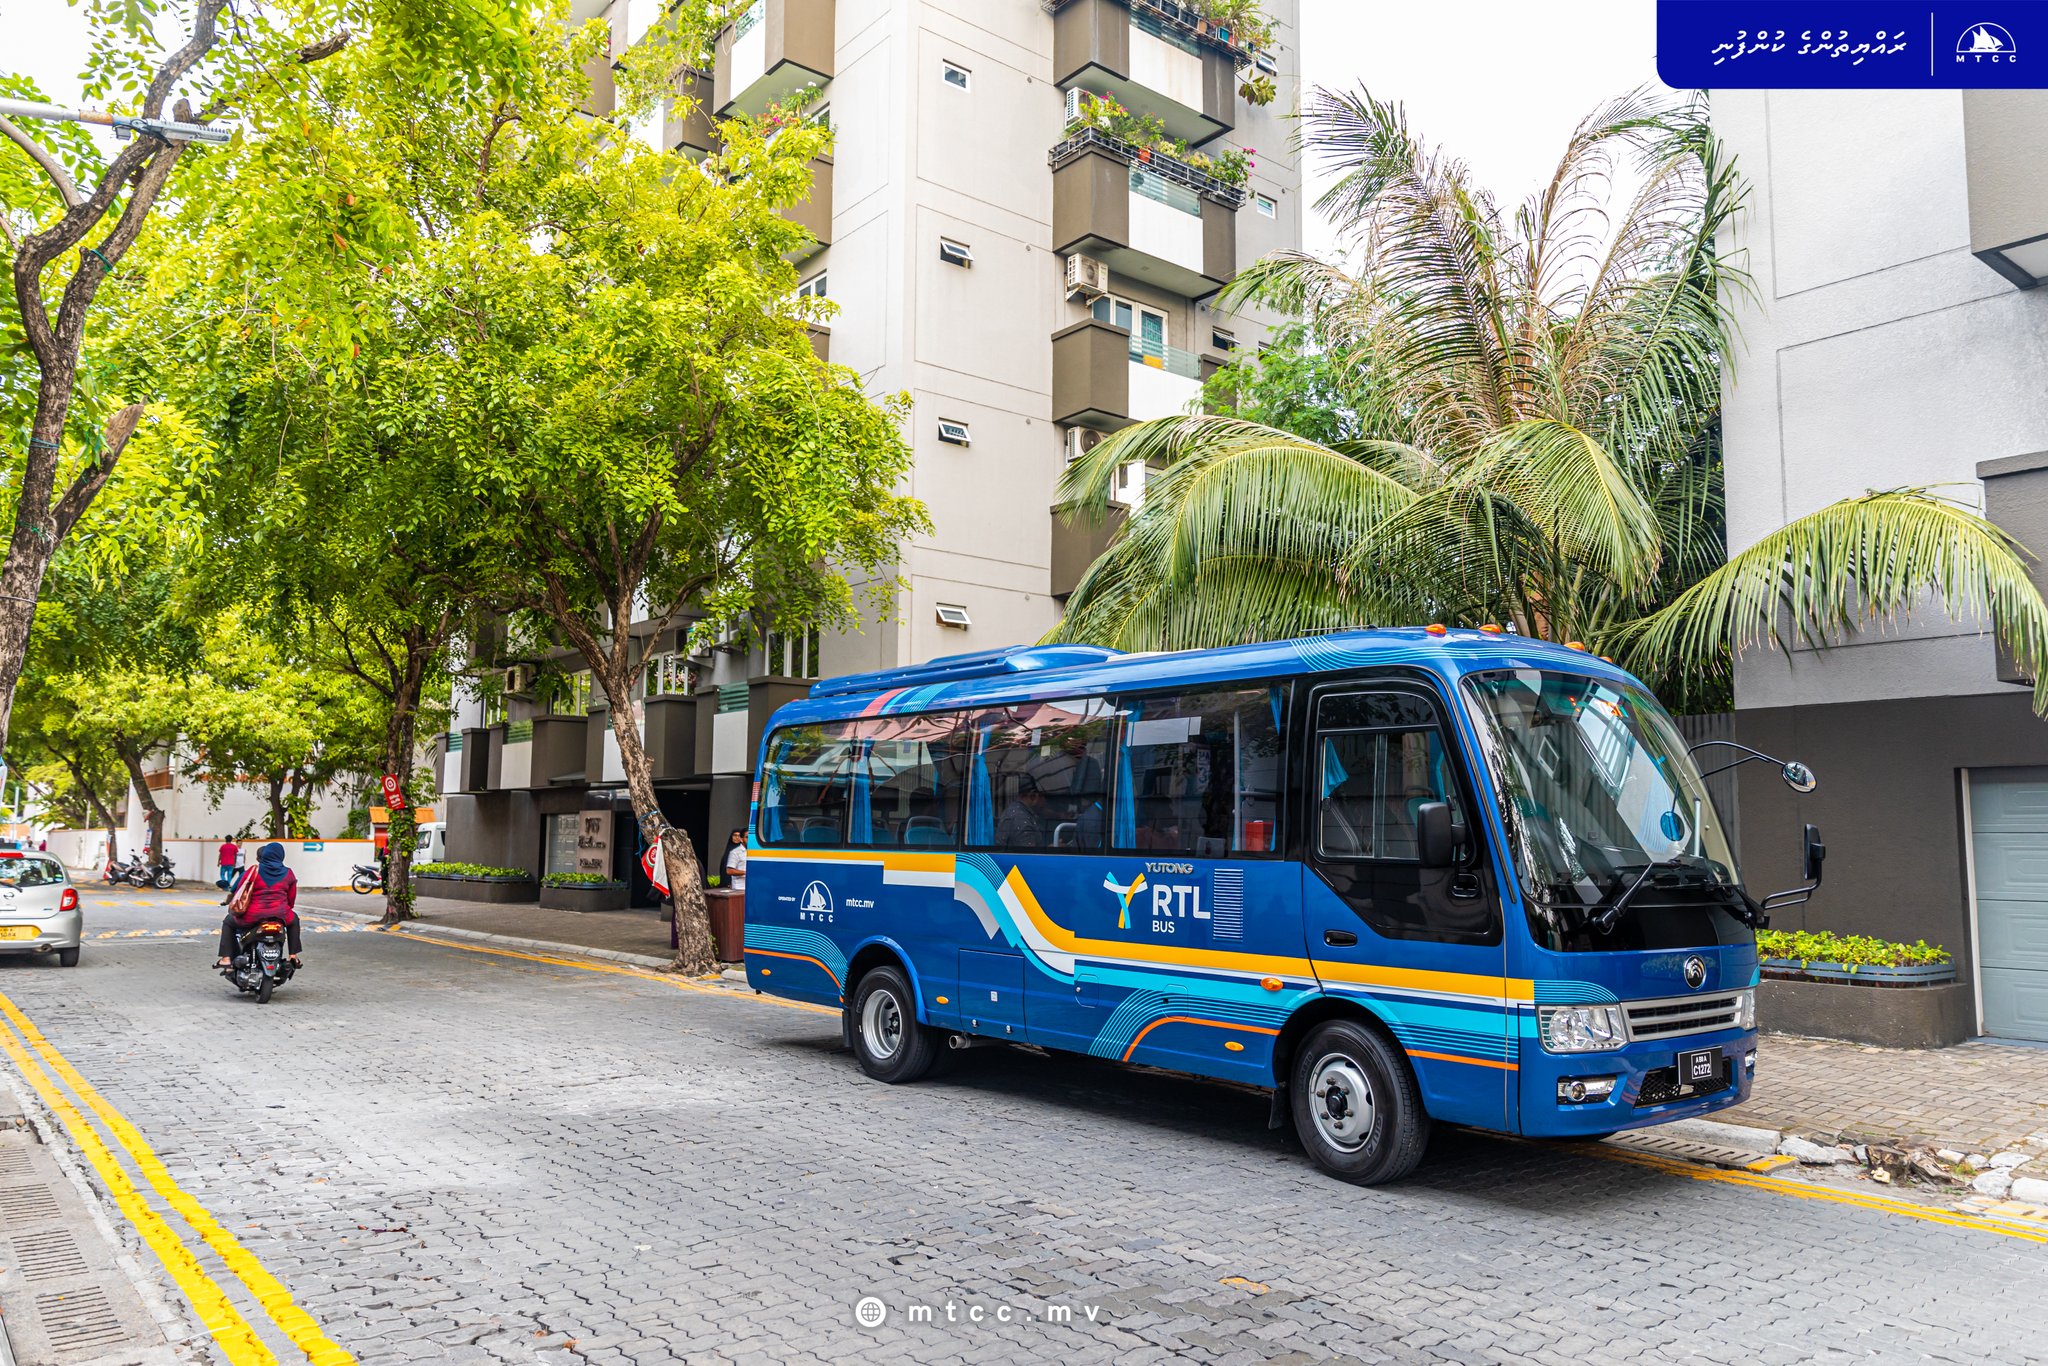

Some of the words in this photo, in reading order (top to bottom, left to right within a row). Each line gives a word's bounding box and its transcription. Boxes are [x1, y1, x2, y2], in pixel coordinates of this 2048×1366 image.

[1145, 862, 1194, 874] YUTONG
[845, 898, 875, 909] mtcc.mv
[1152, 884, 1211, 919] RTL
[1152, 920, 1175, 933] BUS
[1693, 1063, 1711, 1076] C1272
